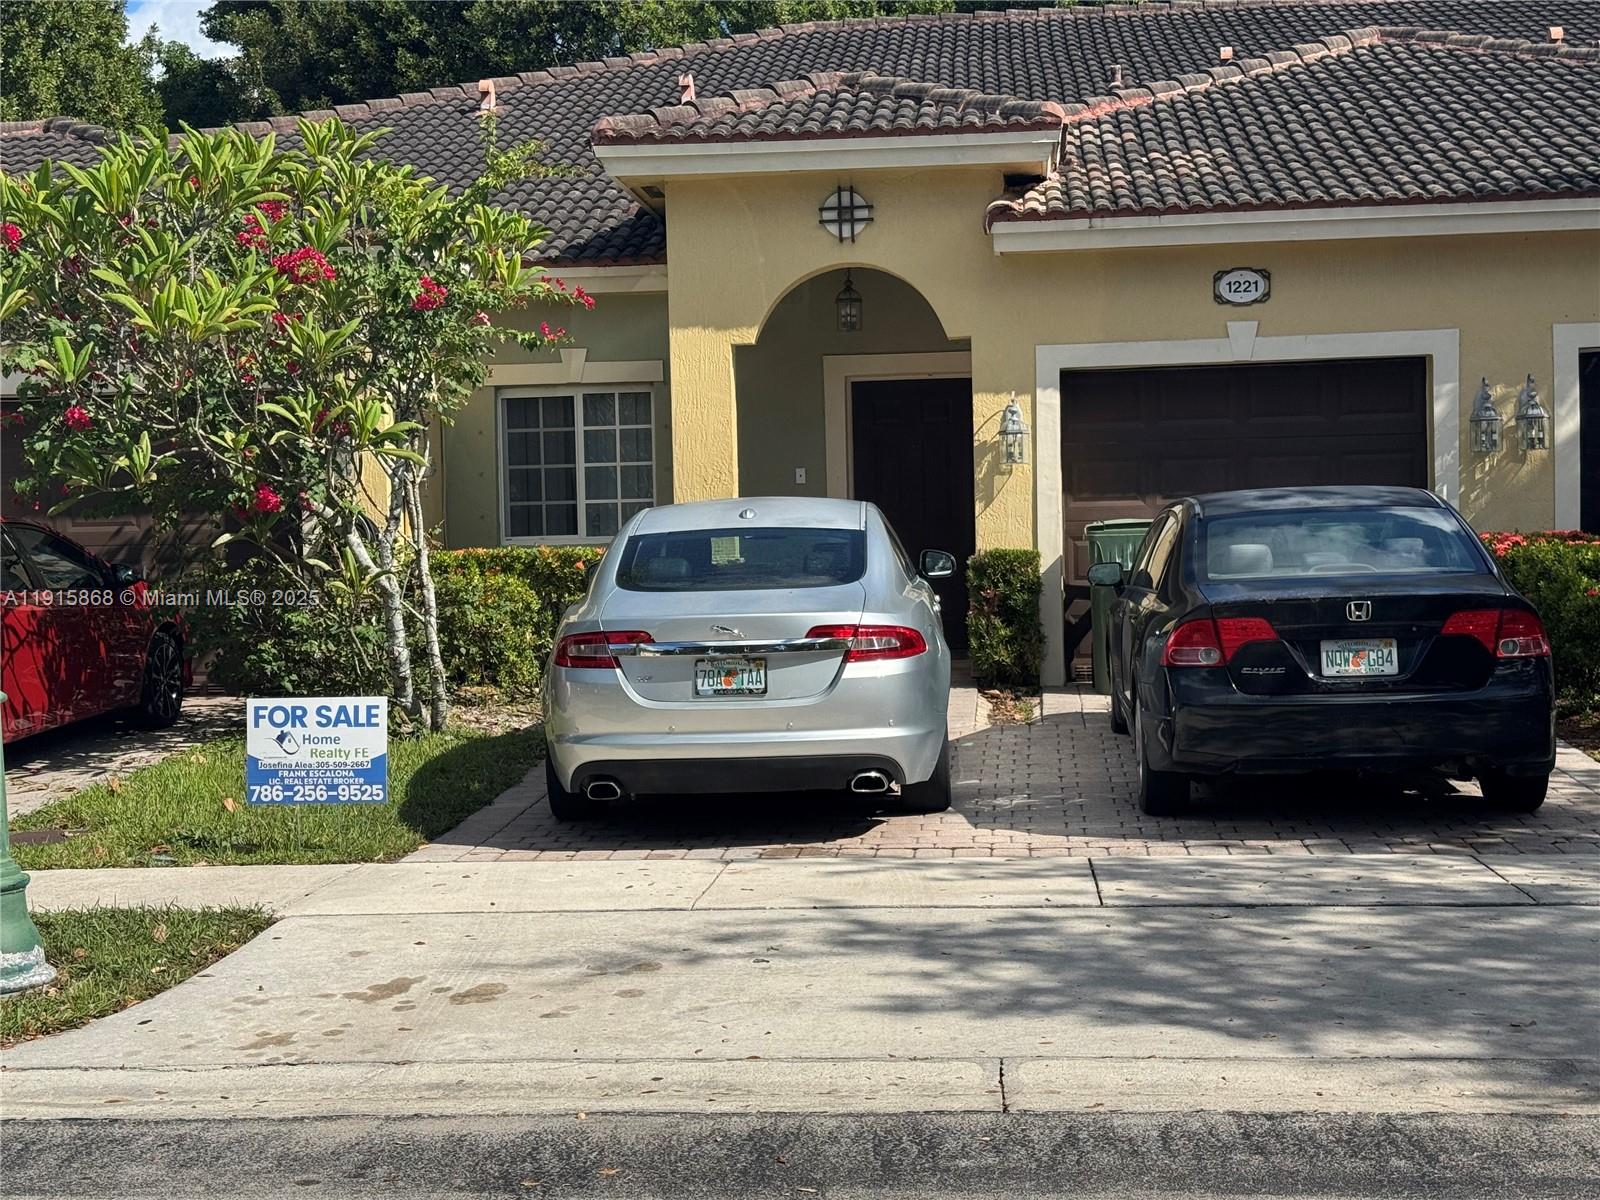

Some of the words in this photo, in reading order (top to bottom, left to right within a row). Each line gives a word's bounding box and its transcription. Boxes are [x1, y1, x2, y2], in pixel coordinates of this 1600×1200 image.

[1226, 280, 1258, 293] 1221
[739, 668, 763, 686] TAA
[254, 705, 308, 728] FOR
[316, 705, 380, 728] SALE
[303, 734, 341, 745] Home
[310, 748, 350, 760] Realty
[355, 748, 369, 758] FE
[259, 761, 293, 769] Josefina
[250, 785, 384, 801] 786-256-9525
